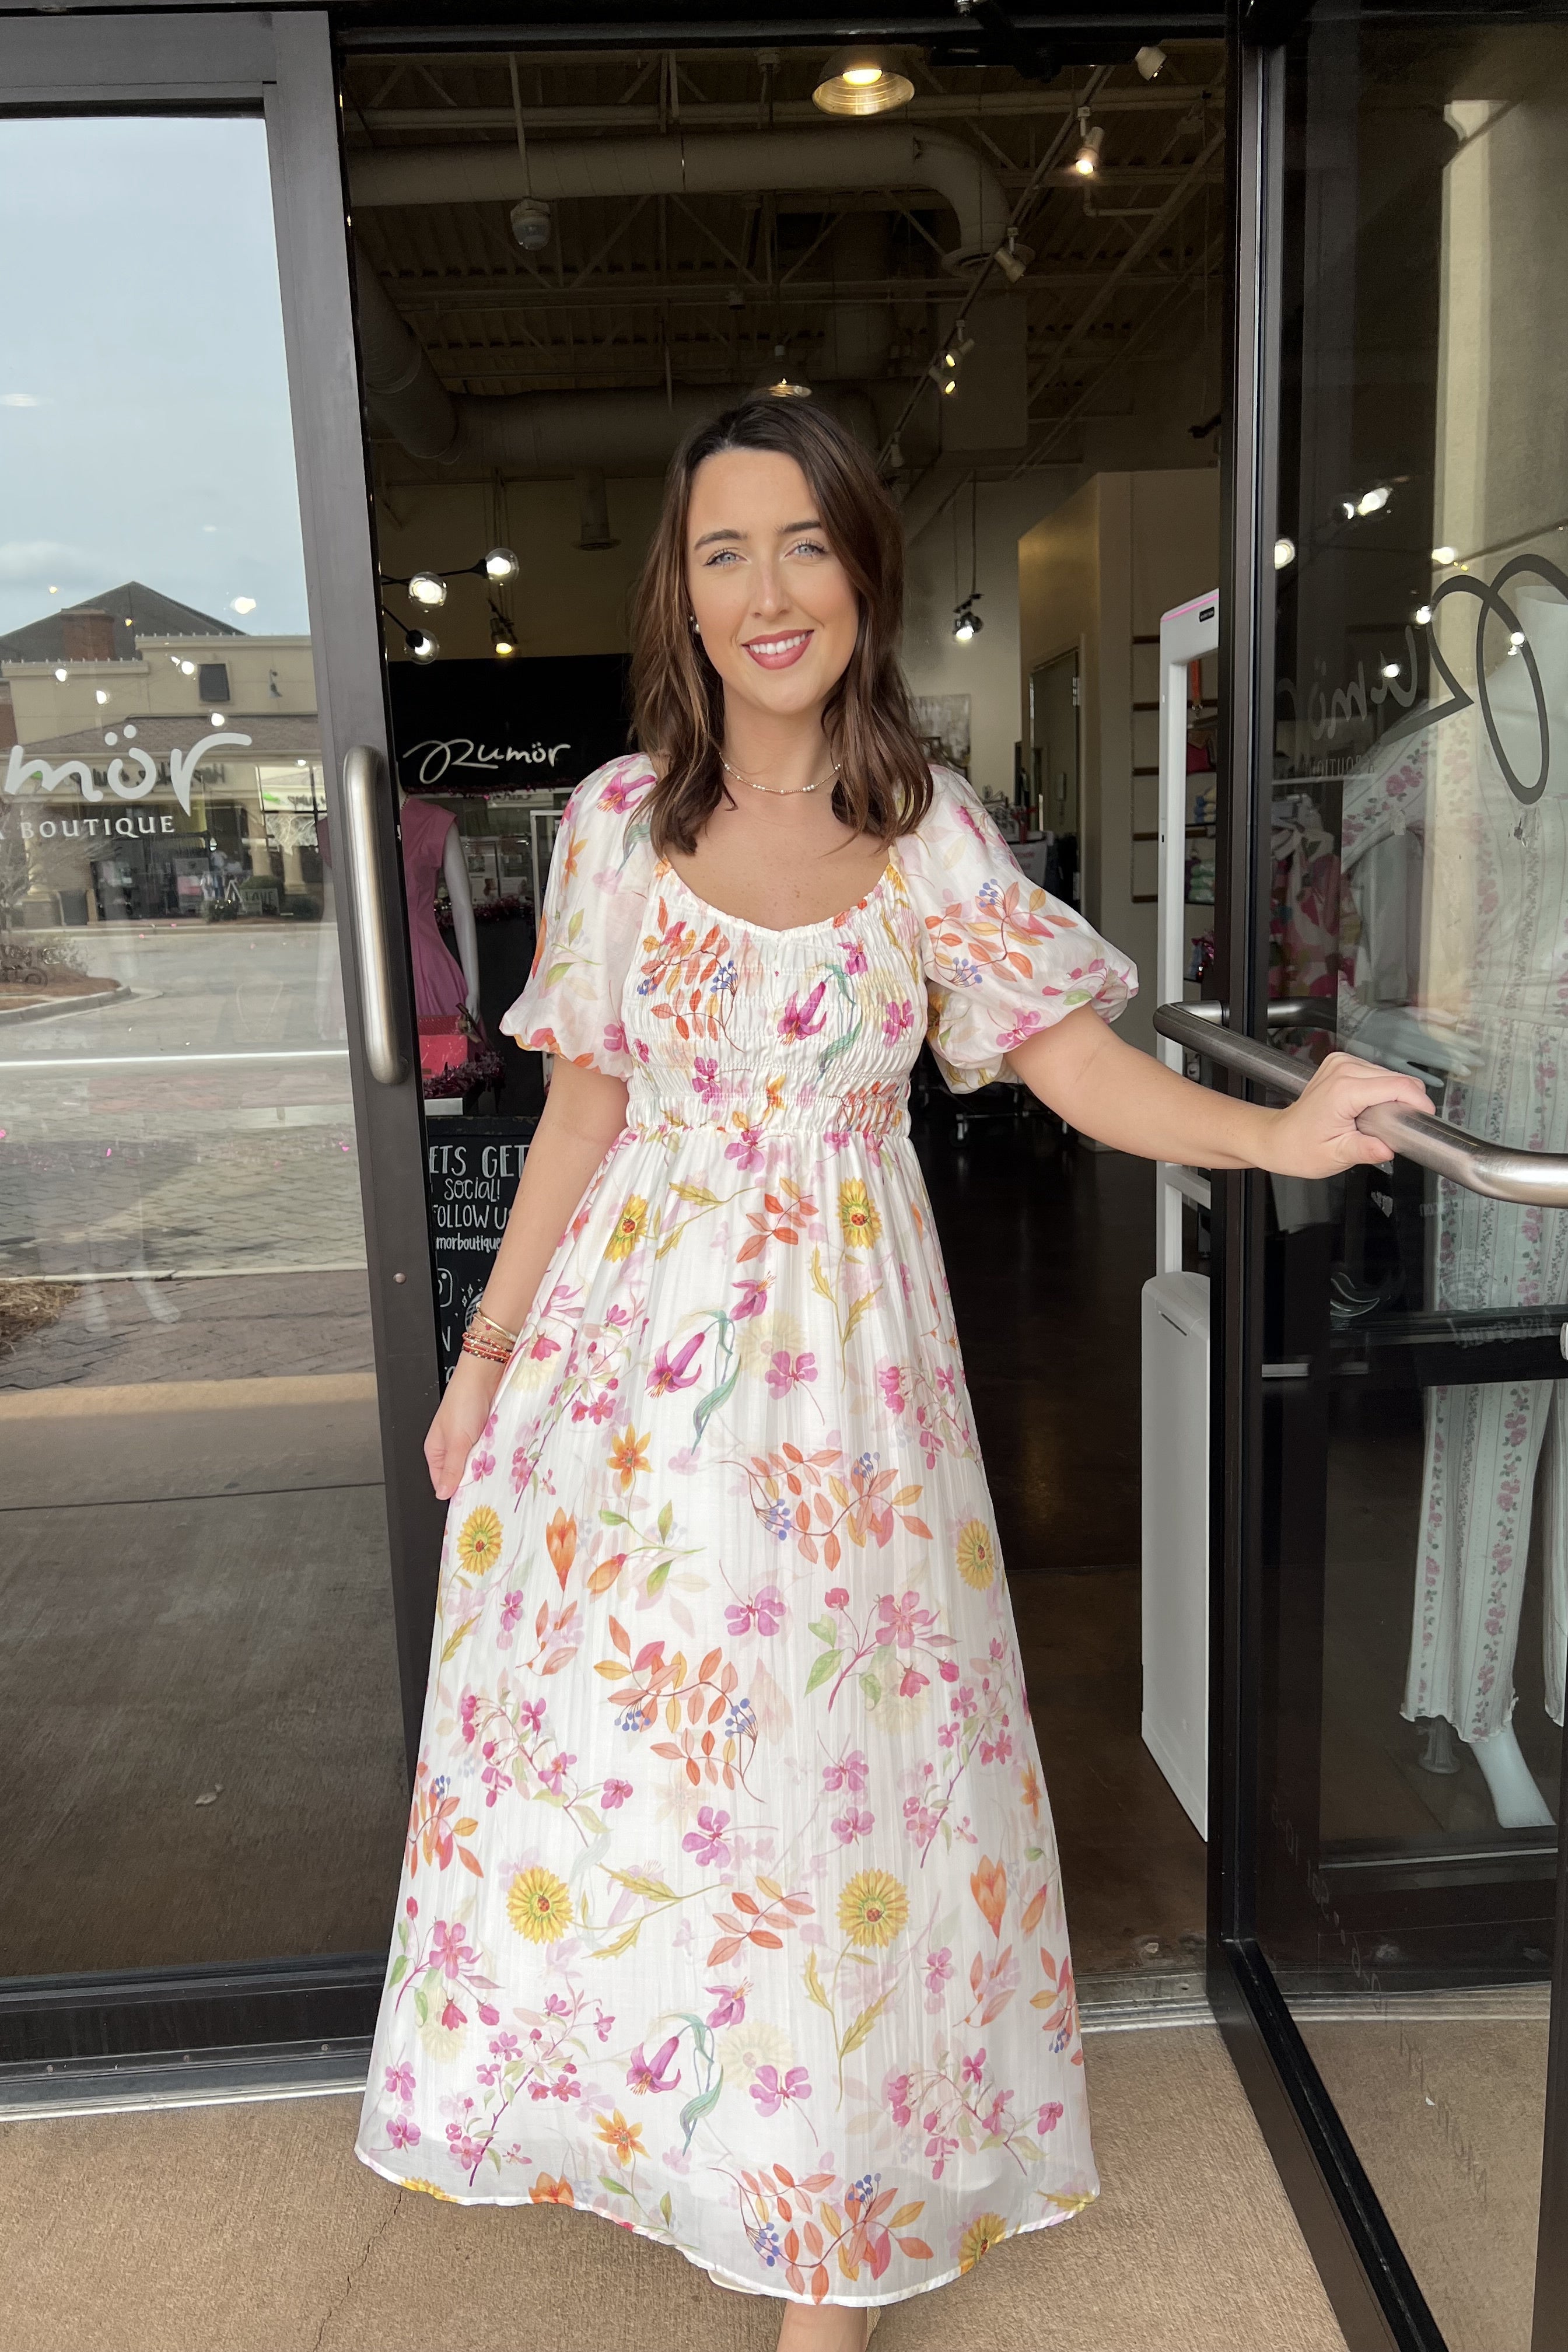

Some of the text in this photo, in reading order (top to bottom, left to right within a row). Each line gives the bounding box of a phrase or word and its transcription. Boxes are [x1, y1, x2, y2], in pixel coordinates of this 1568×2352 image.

[4, 724, 252, 817] mör
[402, 738, 571, 784] Rumör
[20, 816, 174, 839] BOUTIQUE
[482, 1145, 530, 1179] GET
[494, 1206, 511, 1230] U
